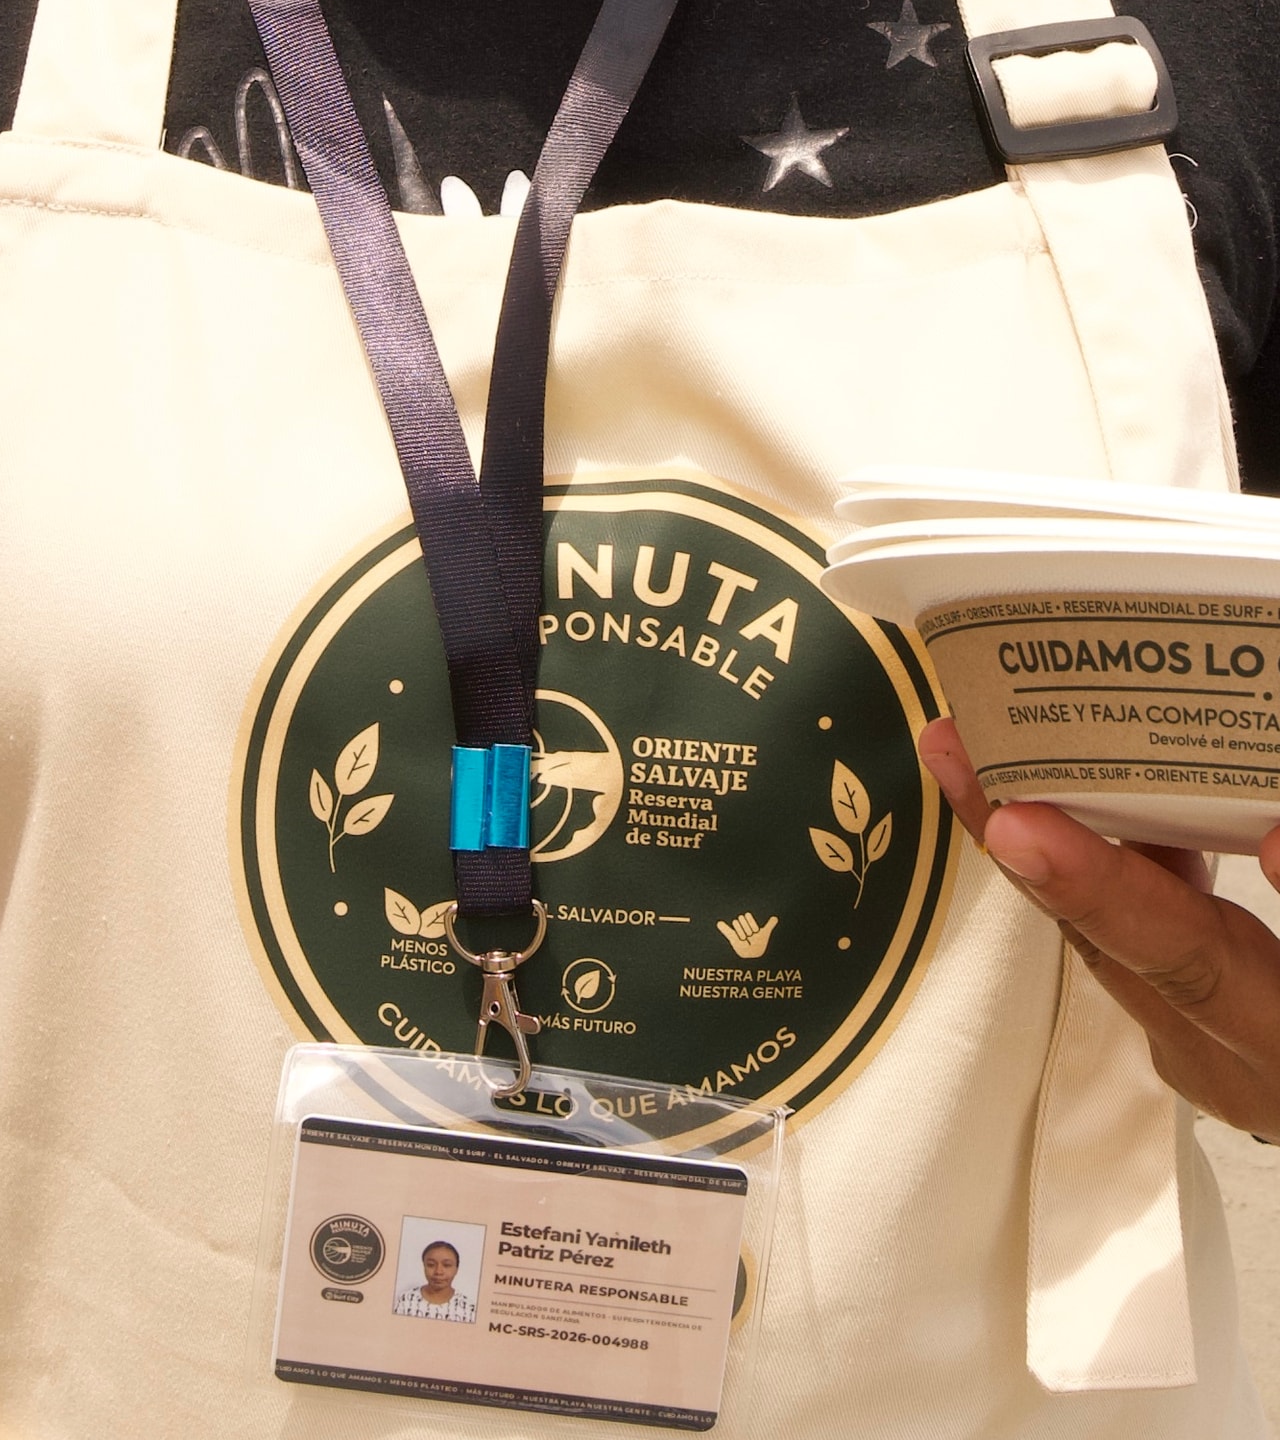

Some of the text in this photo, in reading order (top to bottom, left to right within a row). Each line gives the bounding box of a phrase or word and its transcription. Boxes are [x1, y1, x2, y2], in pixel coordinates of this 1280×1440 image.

[557, 542, 799, 664] NUTA
[966, 605, 1005, 620] ORIENTE
[1006, 601, 1053, 616] SALVAJE
[1063, 600, 1122, 614] RESERVA
[1124, 600, 1195, 616] MUNDIAL
[1198, 603, 1219, 616] DE
[1223, 604, 1263, 619] SURF
[539, 610, 775, 701] PONSABLE
[998, 639, 1192, 675] CUIDAMOS
[1205, 643, 1265, 678] LO
[1008, 703, 1071, 725] ENVASE
[1073, 703, 1085, 722] Y
[1091, 703, 1142, 723] FAJA
[632, 736, 758, 766] ORIENTE
[1149, 732, 1207, 748] Devolvé
[1211, 736, 1224, 749] el
[630, 763, 749, 796] SALVAJE
[1031, 768, 1078, 781] MUNDIAL
[1079, 767, 1096, 780] DE
[1099, 767, 1132, 780] SURF
[1144, 768, 1209, 784] ORIENTE
[1212, 771, 1279, 789] SALVAJE
[628, 789, 713, 812] Reserva
[627, 809, 718, 832] Mundial
[625, 828, 705, 849] de Surf
[557, 905, 656, 926] SALVADOR
[391, 939, 448, 958] MENOS
[380, 954, 456, 976] PLÁSTICO
[683, 967, 802, 983] NUESTRA PLAYA
[679, 985, 803, 1000] NUESTRA GENTE
[538, 1013, 637, 1035] MÁS FUTURO
[536, 1092, 579, 1118] LO
[589, 1093, 658, 1122] QUE
[667, 1025, 798, 1111] AMAMOS
[336, 1133, 370, 1143] SALVAJE
[377, 1139, 413, 1149] RESERVA
[415, 1144, 450, 1154] MUNDIAL
[452, 1147, 464, 1155] DE
[466, 1149, 486, 1158] SURF
[493, 1152, 504, 1160] EL
[506, 1155, 549, 1165] SALVADOR
[556, 1160, 591, 1170] ORIENTE
[633, 1170, 669, 1180] RESERVA
[722, 1180, 742, 1188] SURF
[330, 1220, 370, 1237] MINUTA
[500, 1221, 671, 1256] Estefani Yamileth
[498, 1241, 614, 1268] Patriz Pérez
[494, 1273, 689, 1307] MINUTERA RESPONSABLE
[491, 1301, 548, 1313] MANIPULADOR
[549, 1306, 561, 1314] DE
[562, 1308, 606, 1319] ALIMENTOS
[488, 1322, 649, 1351] MC-SRS-2026-004988
[330, 1372, 346, 1380] QUE
[348, 1374, 383, 1384] AMAMOS
[389, 1380, 418, 1389] MENOS
[420, 1382, 458, 1392] PLÁSTICO
[465, 1387, 482, 1395] MÁS
[484, 1391, 515, 1400] FUTURO
[522, 1395, 559, 1405] NUESTRA
[560, 1399, 586, 1408] PLAYA
[587, 1403, 623, 1412] NUESTRA
[624, 1407, 650, 1416] GENTE
